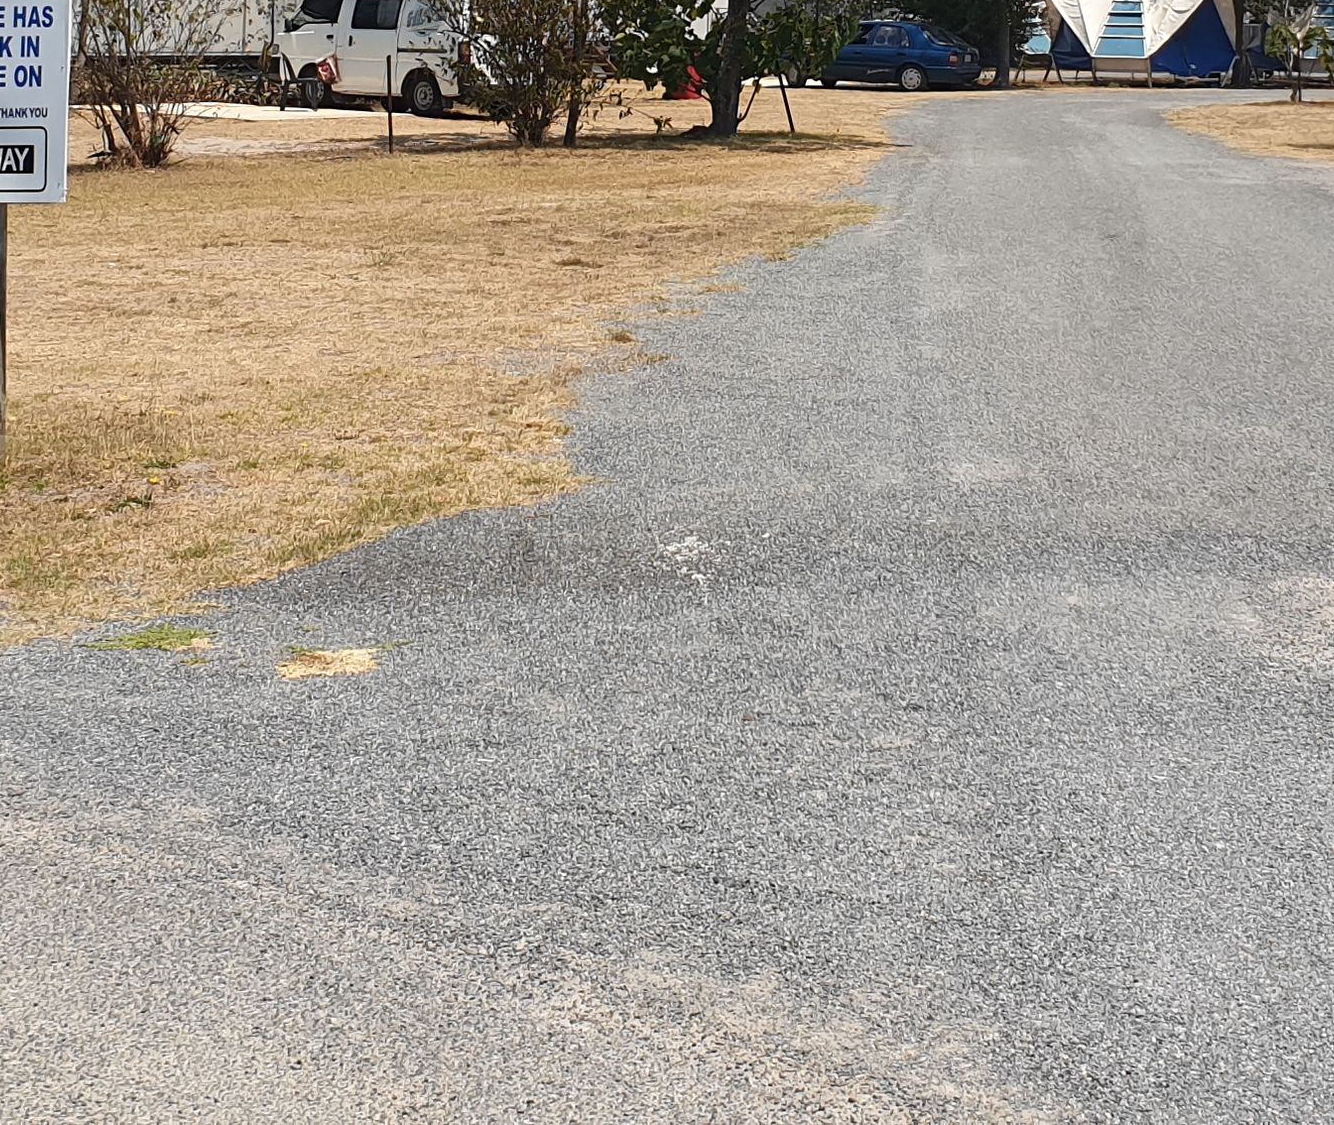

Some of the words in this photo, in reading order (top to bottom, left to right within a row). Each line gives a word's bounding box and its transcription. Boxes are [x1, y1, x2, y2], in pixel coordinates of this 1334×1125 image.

[13, 6, 54, 28] HAS
[20, 36, 40, 57] IN
[14, 65, 42, 87] ON
[29, 107, 48, 118] YOU
